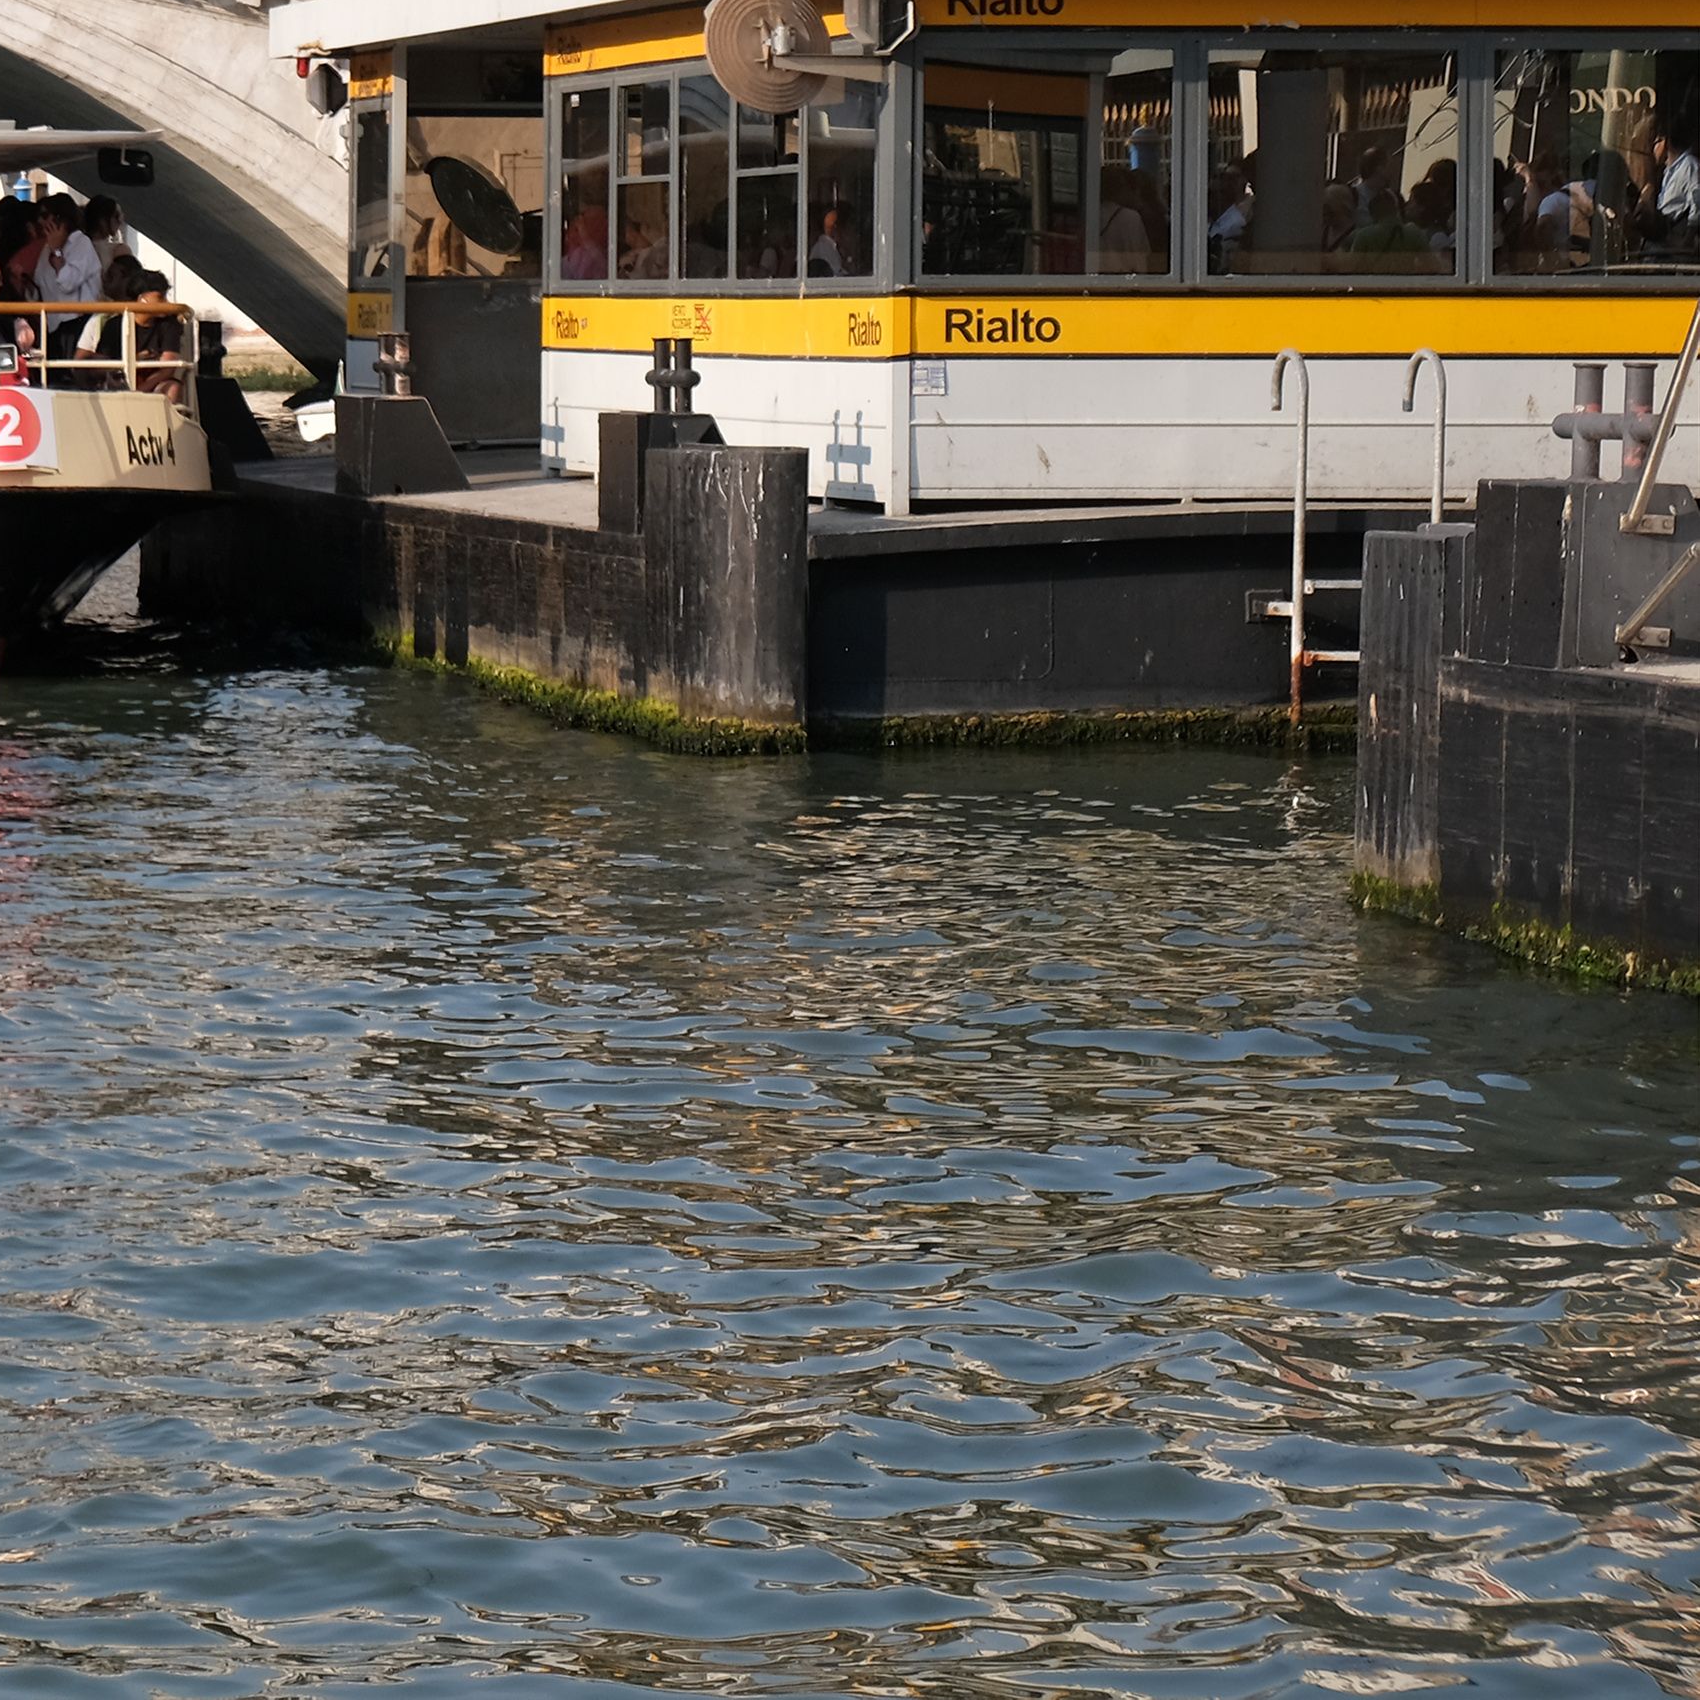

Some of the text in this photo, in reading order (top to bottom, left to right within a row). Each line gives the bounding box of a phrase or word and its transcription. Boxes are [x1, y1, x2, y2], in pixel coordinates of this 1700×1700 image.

[848, 311, 882, 347] Rialto
[945, 307, 1062, 343] Rialto
[125, 424, 164, 467] Actv
